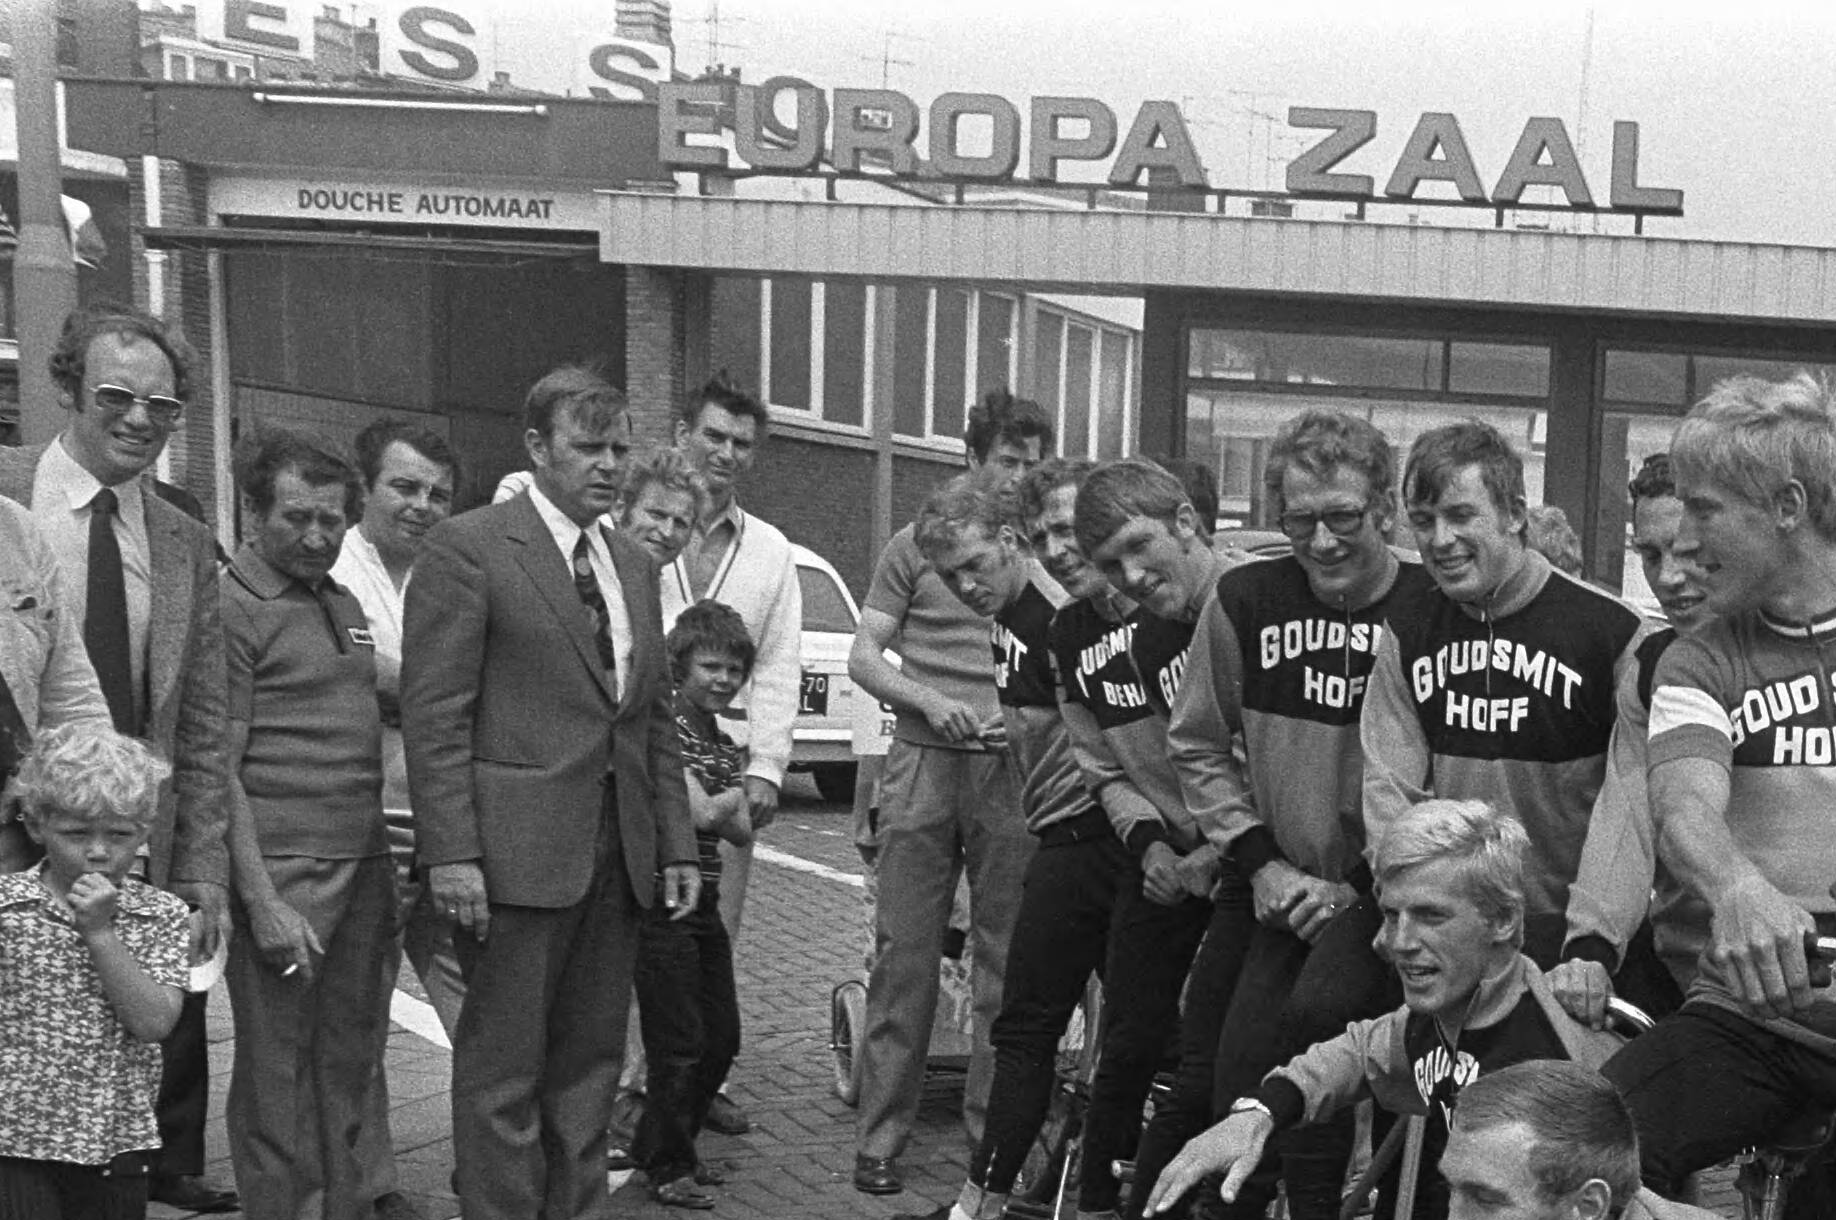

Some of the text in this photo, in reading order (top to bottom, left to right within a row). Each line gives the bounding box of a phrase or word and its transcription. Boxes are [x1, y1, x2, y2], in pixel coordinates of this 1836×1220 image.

[658, 82, 1683, 213] EUROPA ZAAL
[297, 188, 554, 220] DOUCHE AUTOMAAT
[1412, 638, 1582, 710] GOUDSMIT
[1446, 690, 1529, 732] HOFF
